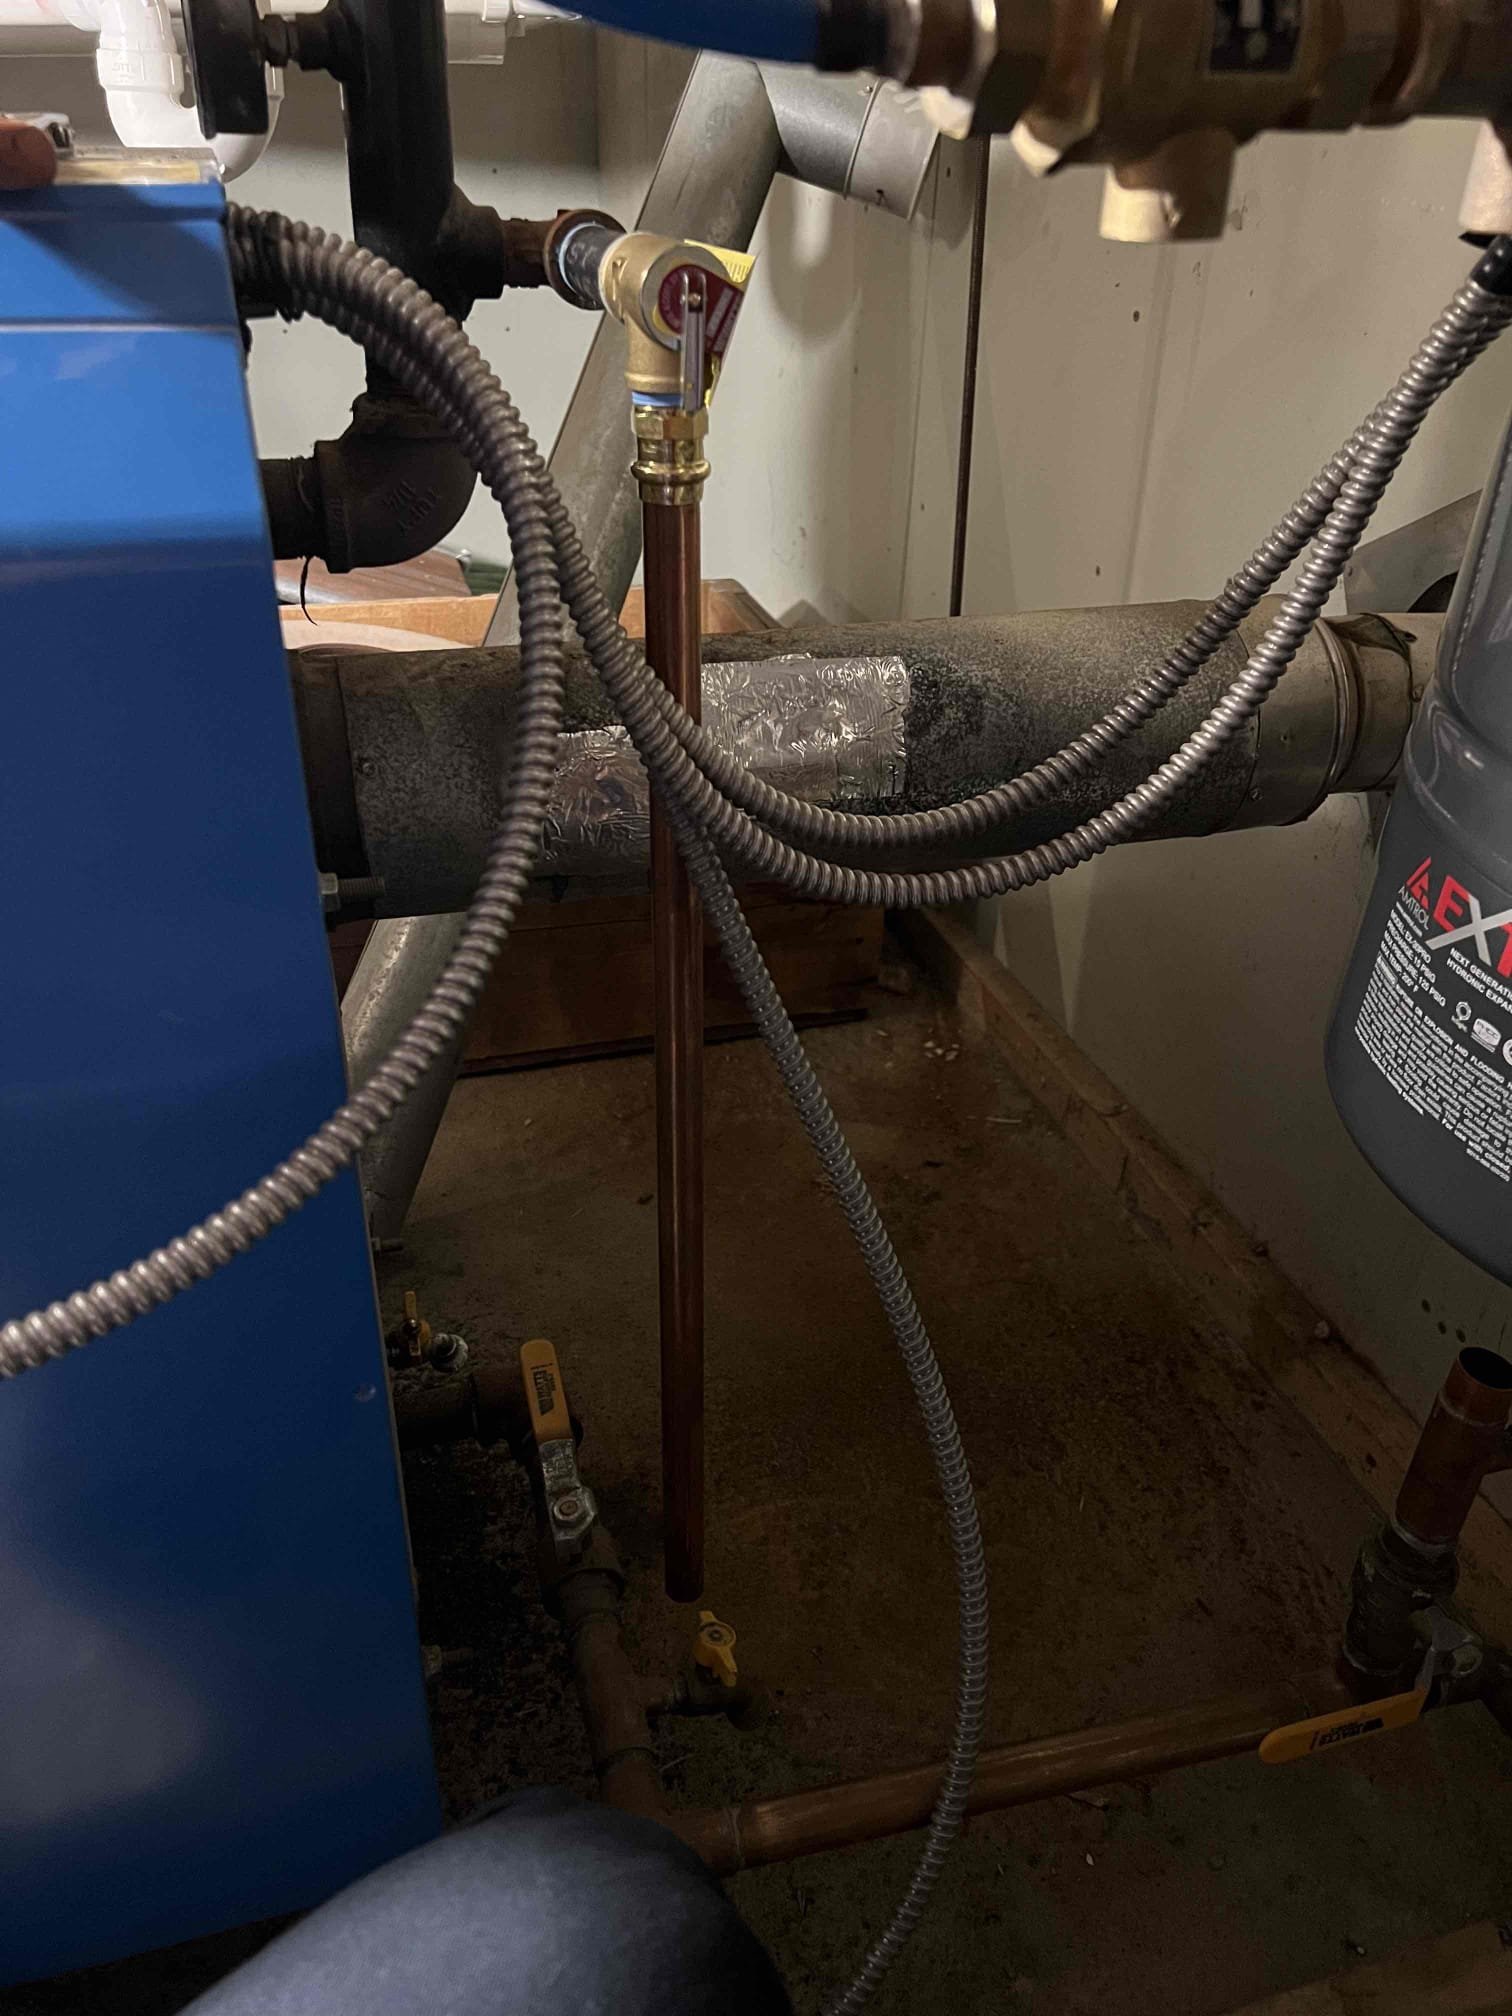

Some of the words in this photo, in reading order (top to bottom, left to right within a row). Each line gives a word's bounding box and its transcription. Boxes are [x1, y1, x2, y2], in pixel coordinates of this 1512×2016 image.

[1398, 886, 1429, 930] AMTROL
[1447, 957, 1485, 993] HYDRONIC
[1450, 947, 1470, 967] NEXT
[1455, 1043, 1469, 1057] AND
[1470, 1055, 1505, 1083] FLOODING
[1453, 1129, 1467, 1141] use
[1468, 1140, 1483, 1154] with
